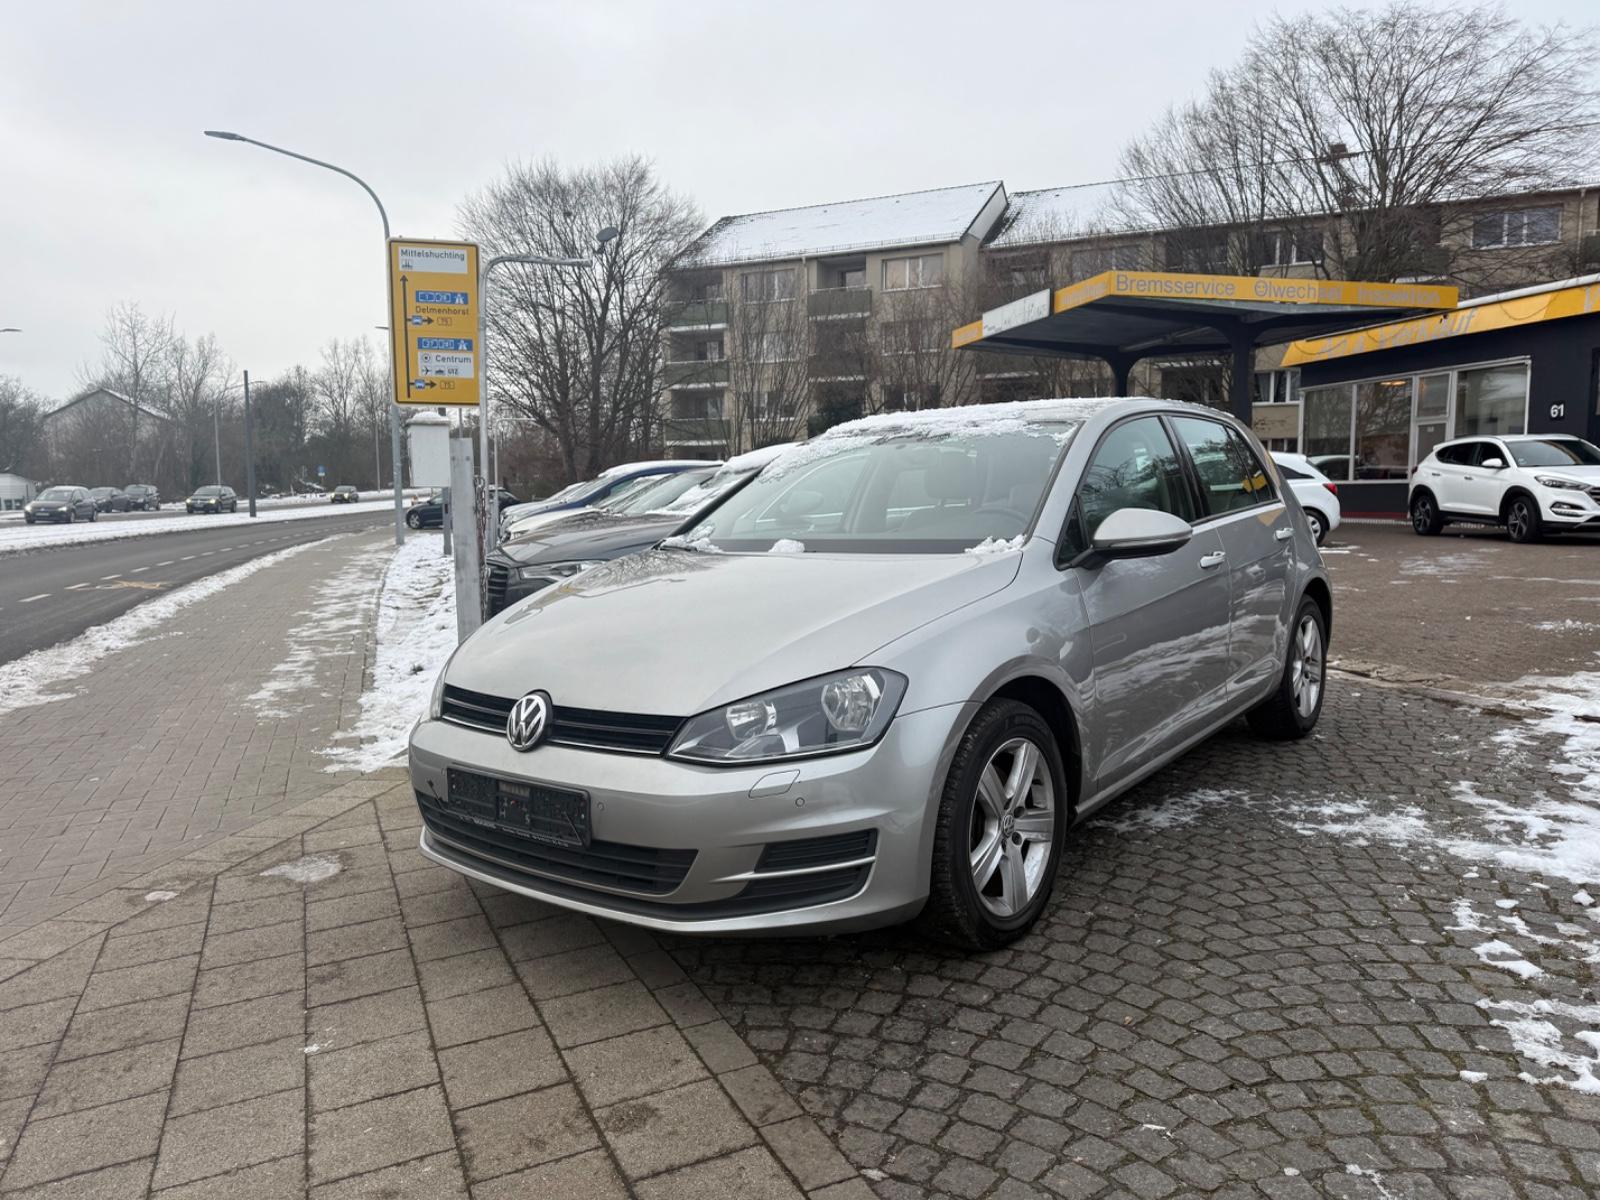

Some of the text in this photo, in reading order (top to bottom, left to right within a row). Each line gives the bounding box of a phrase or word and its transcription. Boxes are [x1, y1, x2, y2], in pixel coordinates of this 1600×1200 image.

[400, 248, 465, 261] Mittelshuchting
[1116, 273, 1236, 296] Bremsservice
[415, 305, 469, 316] Delmenhorst
[435, 354, 472, 364] Centrum
[1550, 403, 1565, 418] 61
